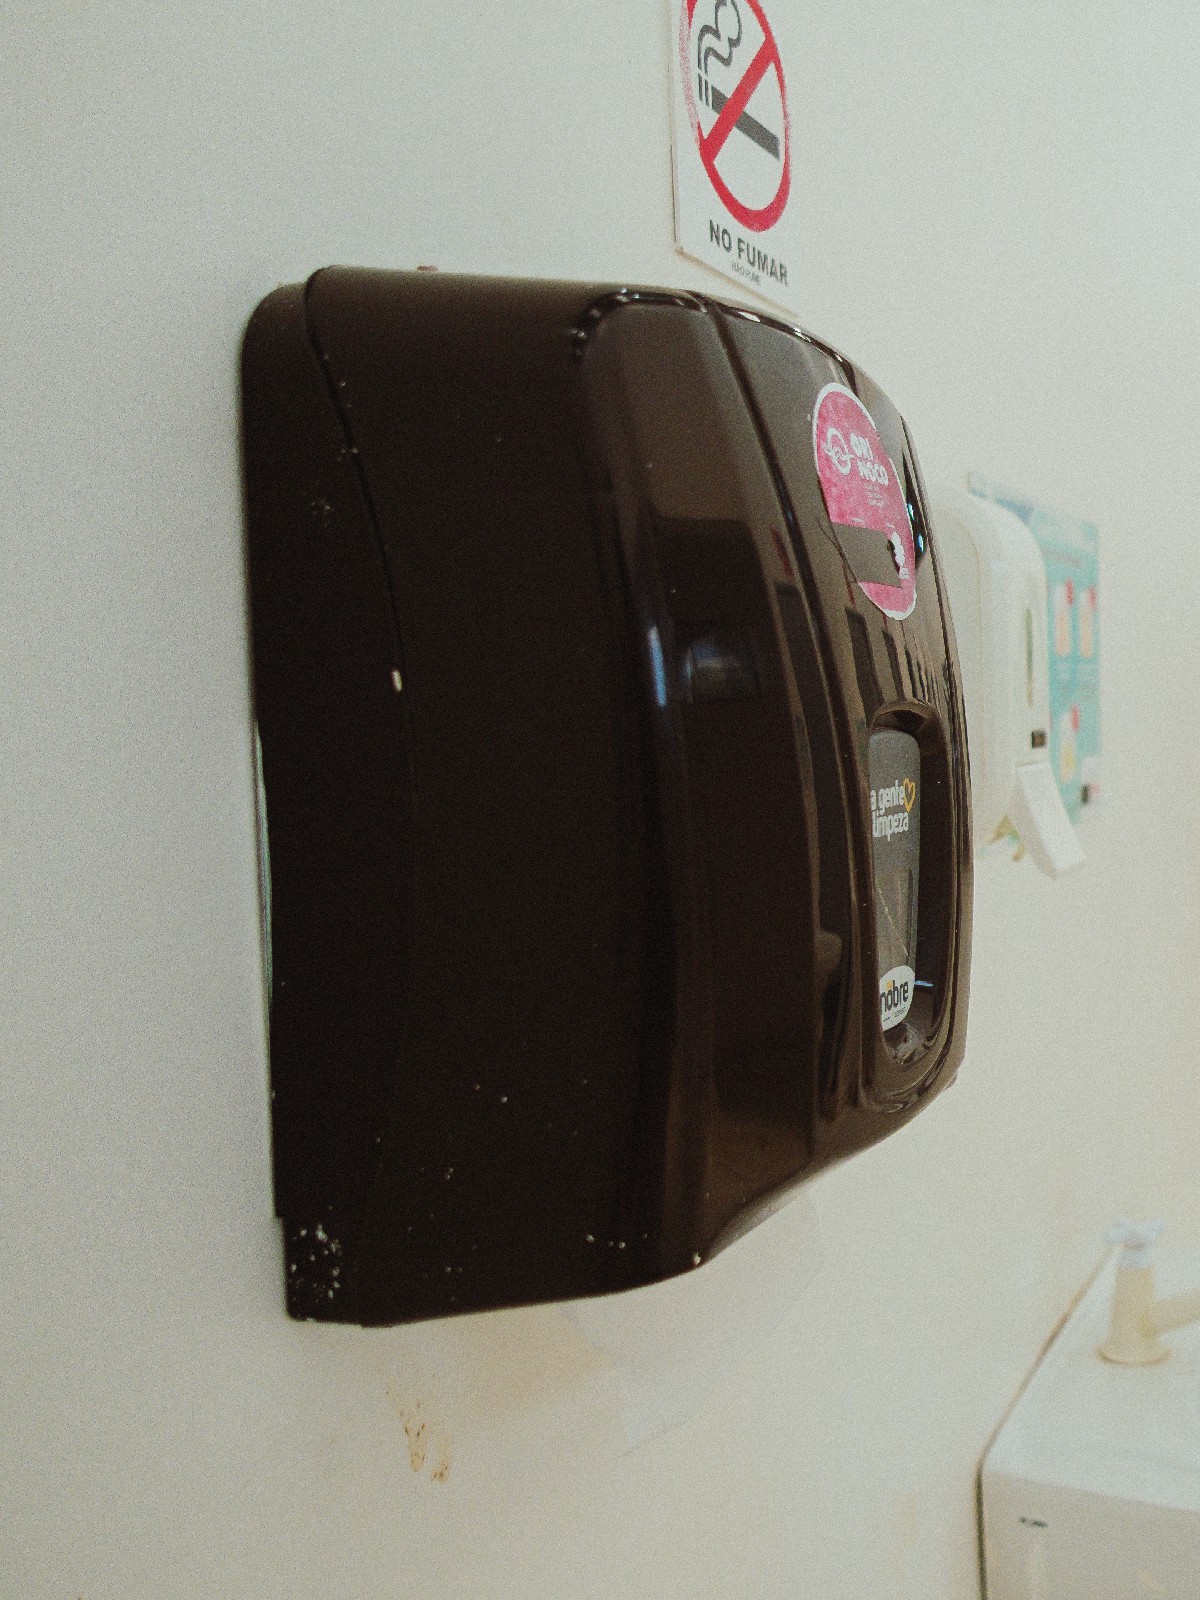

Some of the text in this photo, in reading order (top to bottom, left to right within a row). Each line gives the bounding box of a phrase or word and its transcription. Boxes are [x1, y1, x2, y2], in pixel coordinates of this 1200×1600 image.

[709, 219, 789, 287] NO FUMAR
[869, 779, 905, 816] a gente
[871, 810, 909, 842] limpeza
[880, 979, 909, 1013] nobre
